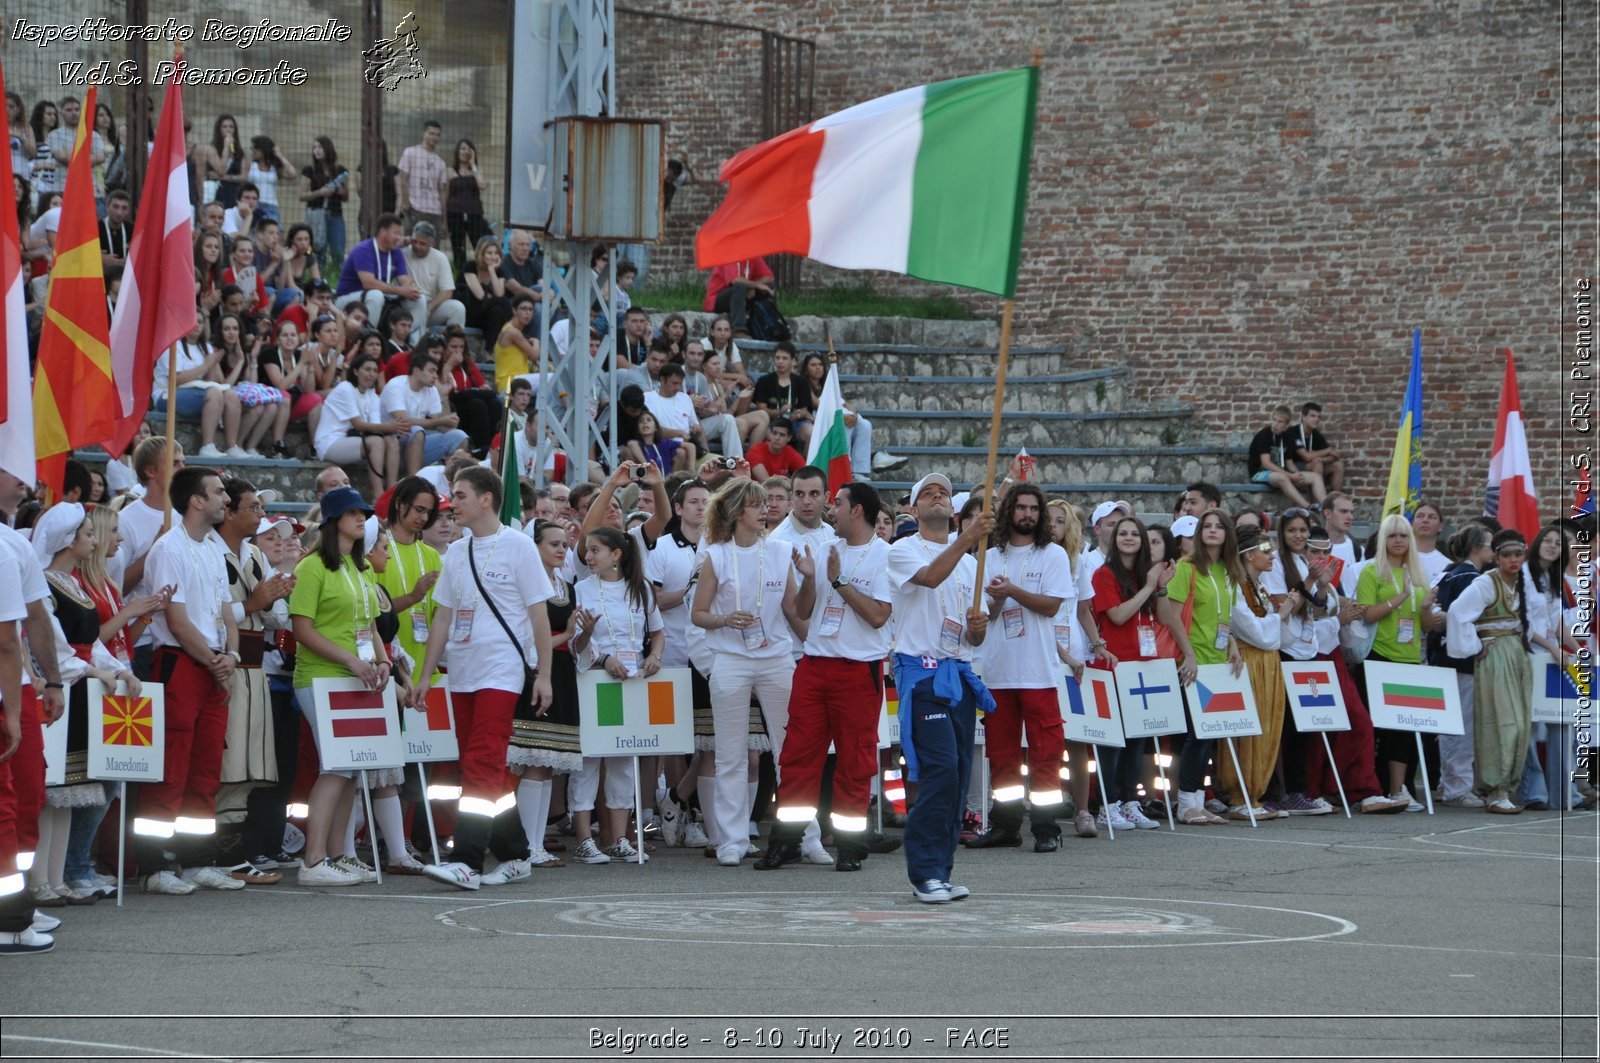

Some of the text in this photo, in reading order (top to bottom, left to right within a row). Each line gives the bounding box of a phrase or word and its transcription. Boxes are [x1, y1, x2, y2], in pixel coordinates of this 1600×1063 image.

[1142, 717, 1169, 730] Finland
[1201, 718, 1254, 732] Czech Republic
[1311, 715, 1334, 726] Croatia
[1396, 713, 1439, 727] Bulgaria
[1083, 725, 1106, 739] France
[615, 734, 660, 749] Ireland
[350, 748, 377, 762] Latvia
[408, 741, 432, 757] Italy
[105, 756, 149, 772] Macedonia
